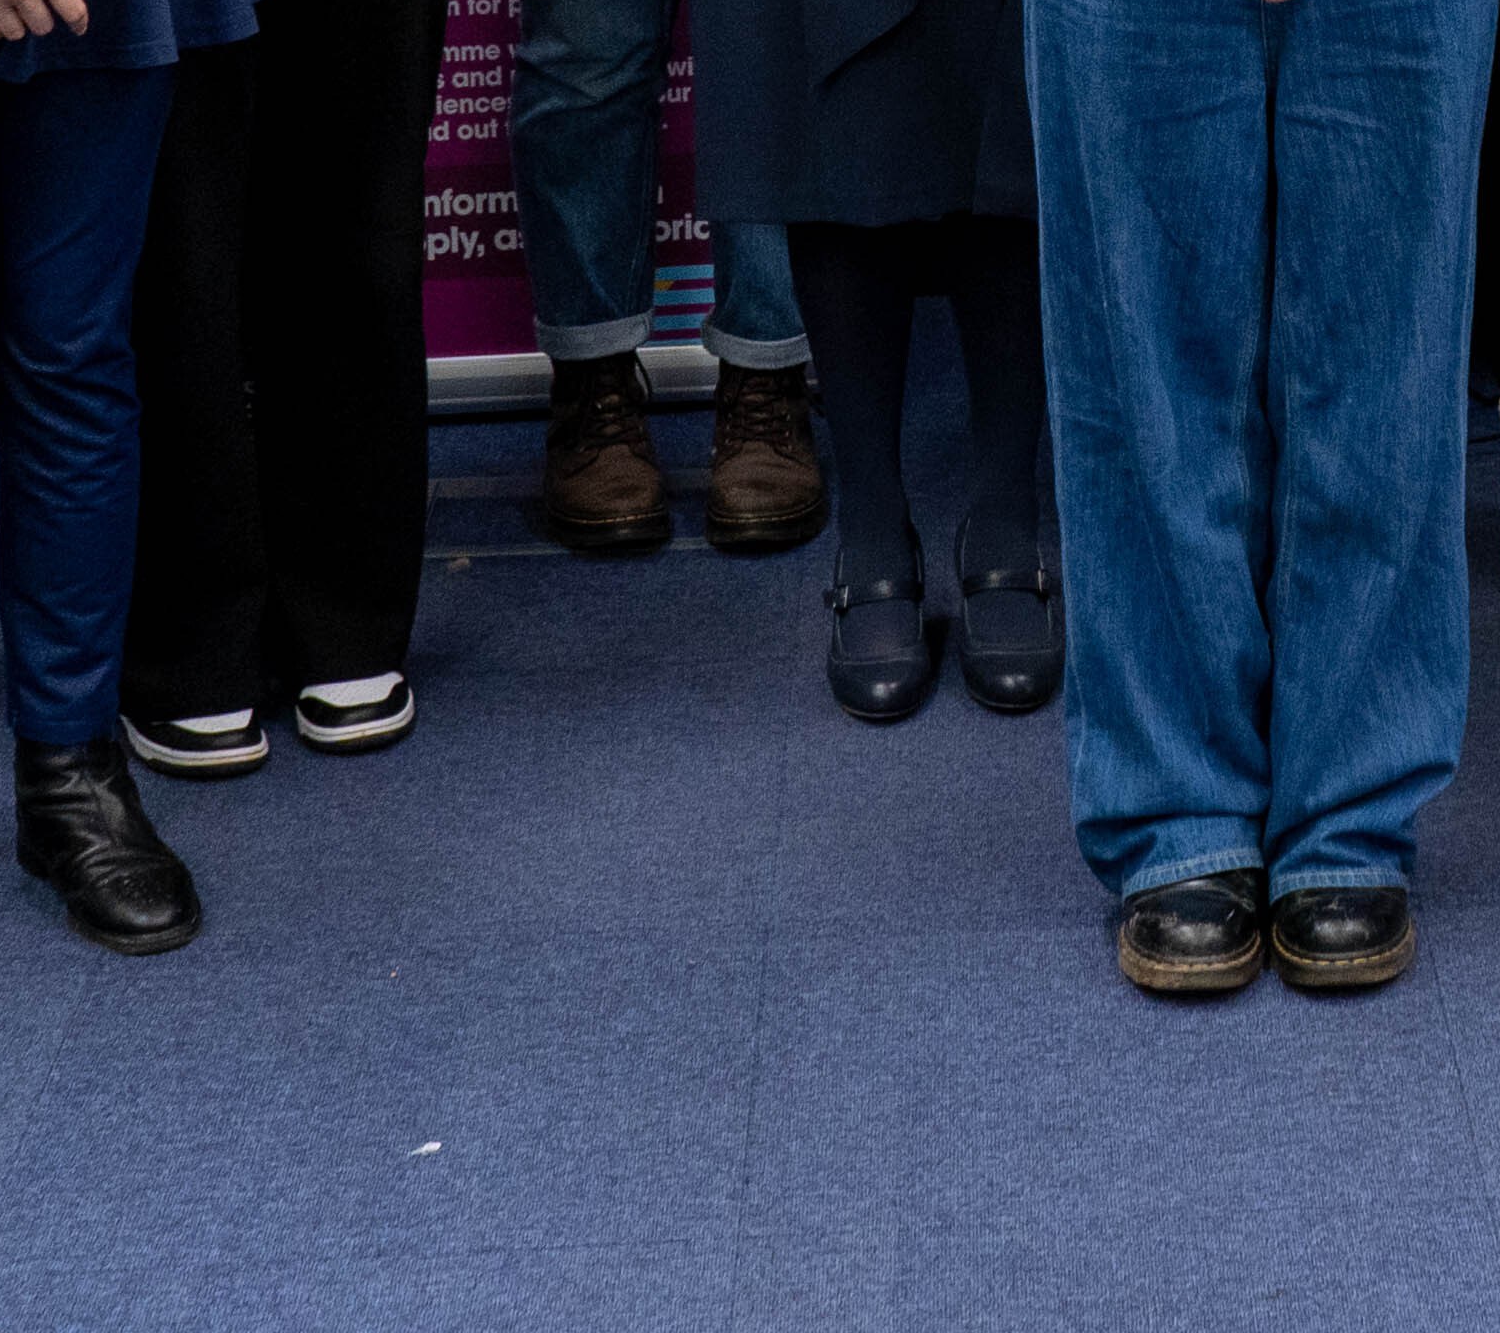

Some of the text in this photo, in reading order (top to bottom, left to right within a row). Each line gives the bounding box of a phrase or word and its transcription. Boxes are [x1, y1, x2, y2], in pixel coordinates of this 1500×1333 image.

[452, 65, 502, 89] and
[457, 118, 500, 140] out
[425, 187, 518, 218] nform
[424, 225, 486, 261] ply,
